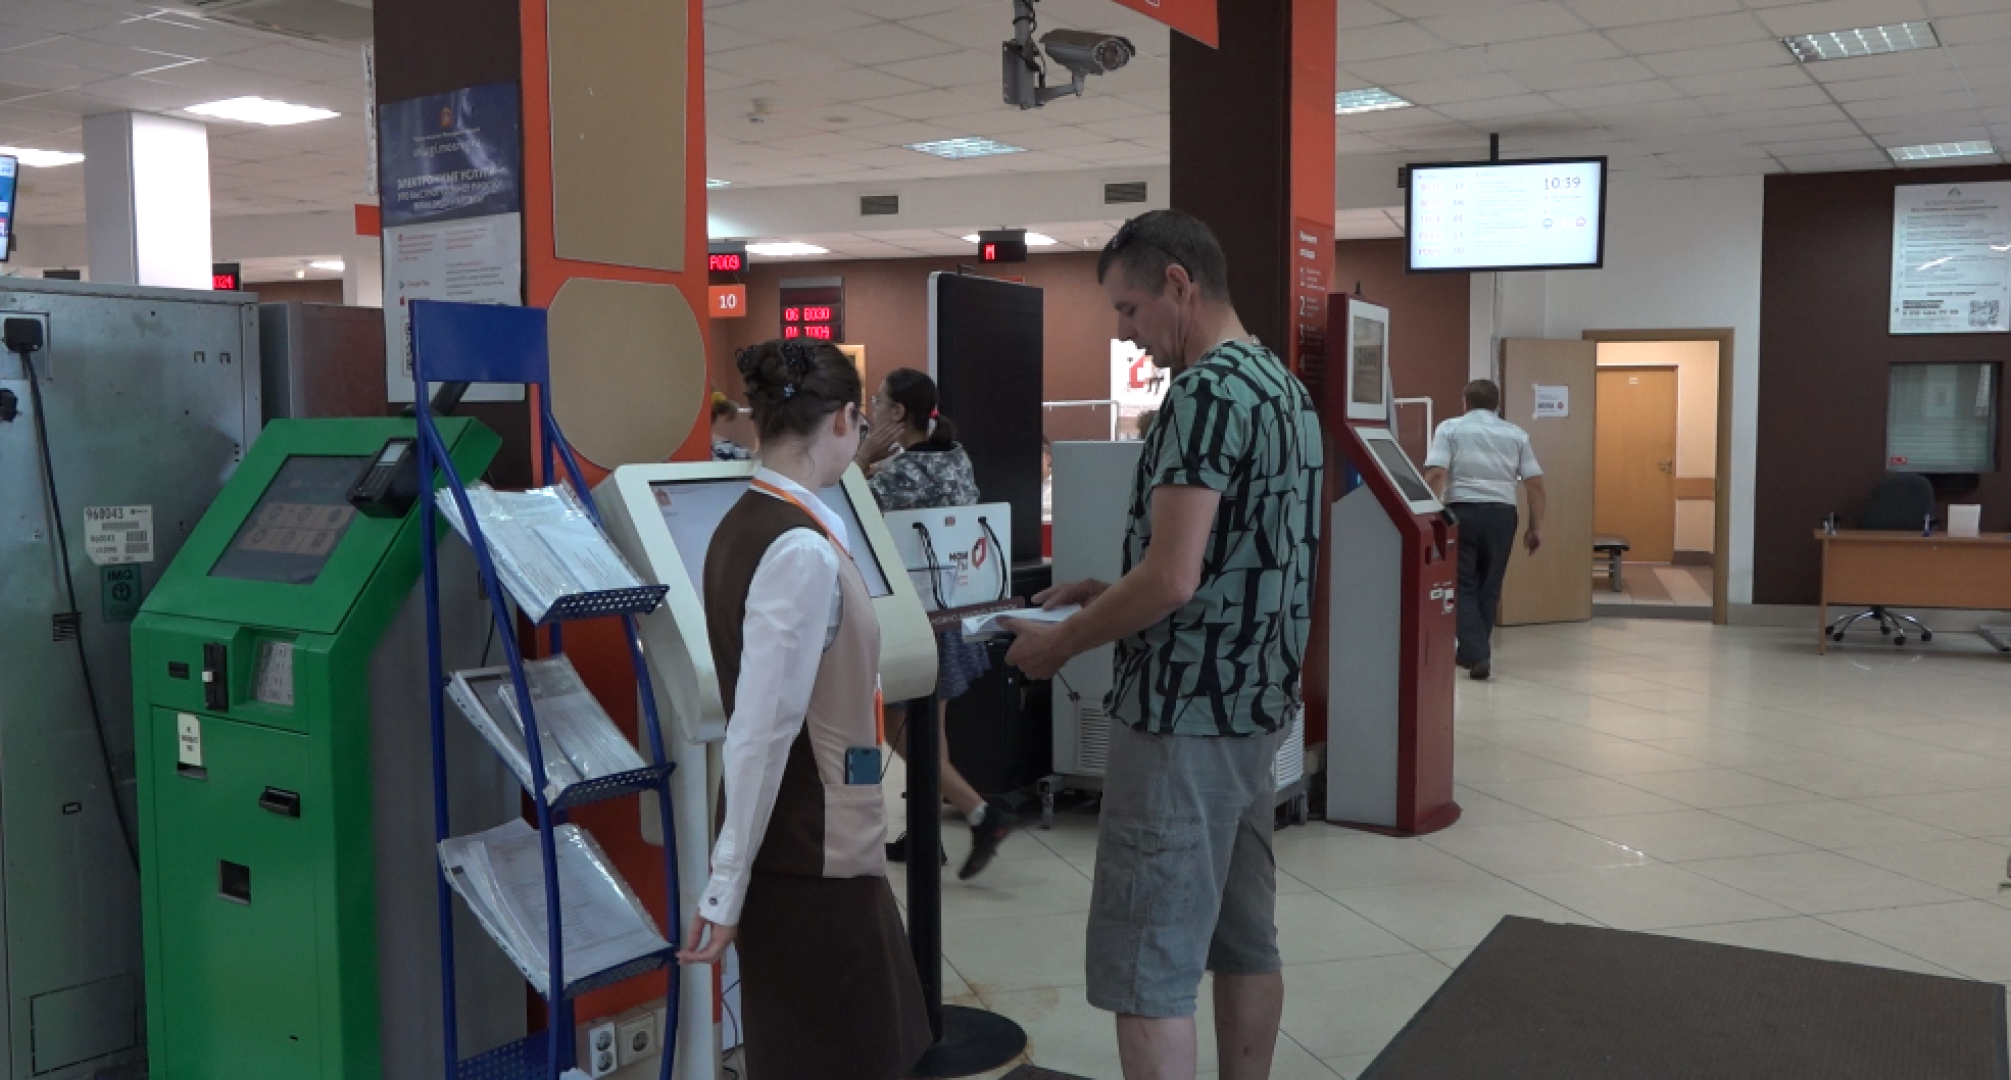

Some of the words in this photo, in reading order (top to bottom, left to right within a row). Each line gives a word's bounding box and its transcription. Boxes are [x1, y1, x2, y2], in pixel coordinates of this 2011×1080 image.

[1543, 175, 1581, 190] 10:39
[718, 294, 737, 309] 10
[85, 507, 124, 521] 960043
[107, 569, 133, 582] IMQ
